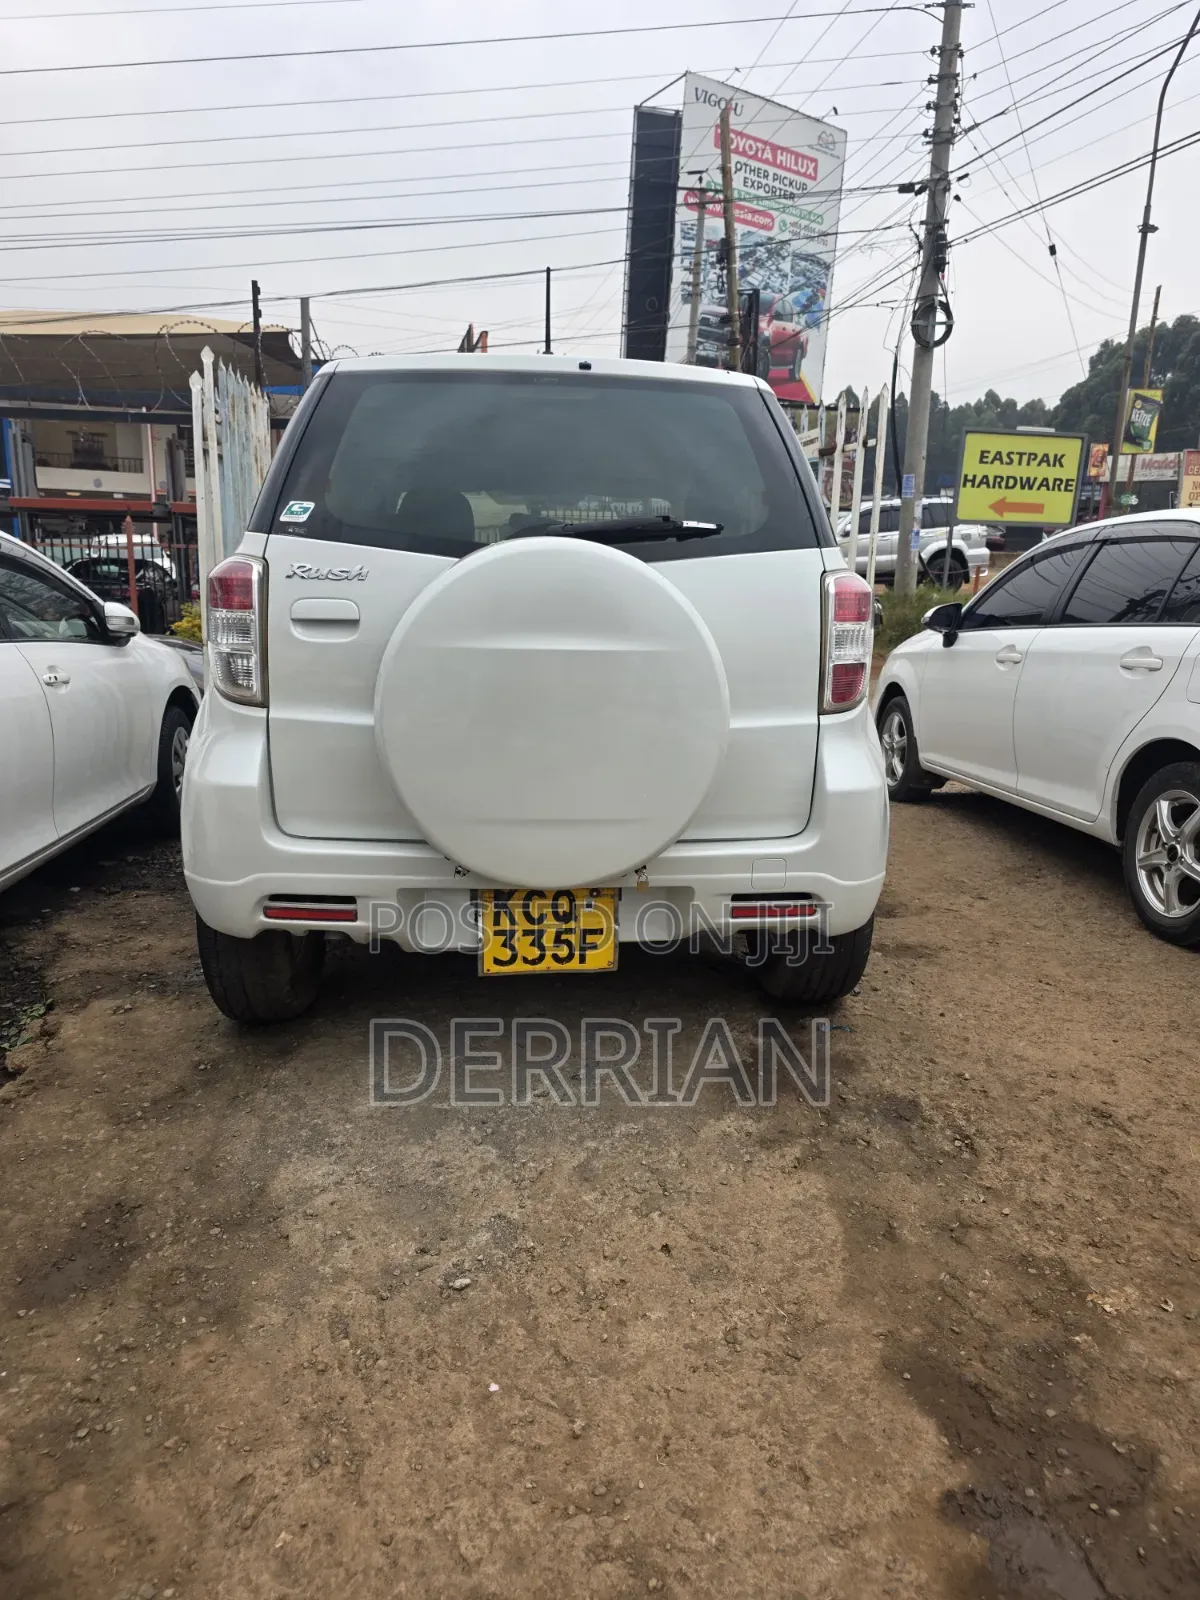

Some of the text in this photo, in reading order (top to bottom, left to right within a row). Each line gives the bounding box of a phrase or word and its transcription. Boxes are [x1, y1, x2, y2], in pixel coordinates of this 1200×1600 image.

[718, 127, 772, 162] OYOTA
[776, 149, 816, 177] HILUX
[735, 160, 808, 192] OTHER PICKUP
[743, 176, 796, 202] EXPORTER
[978, 450, 1066, 468] EASTPAK
[962, 473, 1075, 493] HARDWARE
[493, 889, 579, 926] KCQ
[493, 927, 604, 967] 335F
